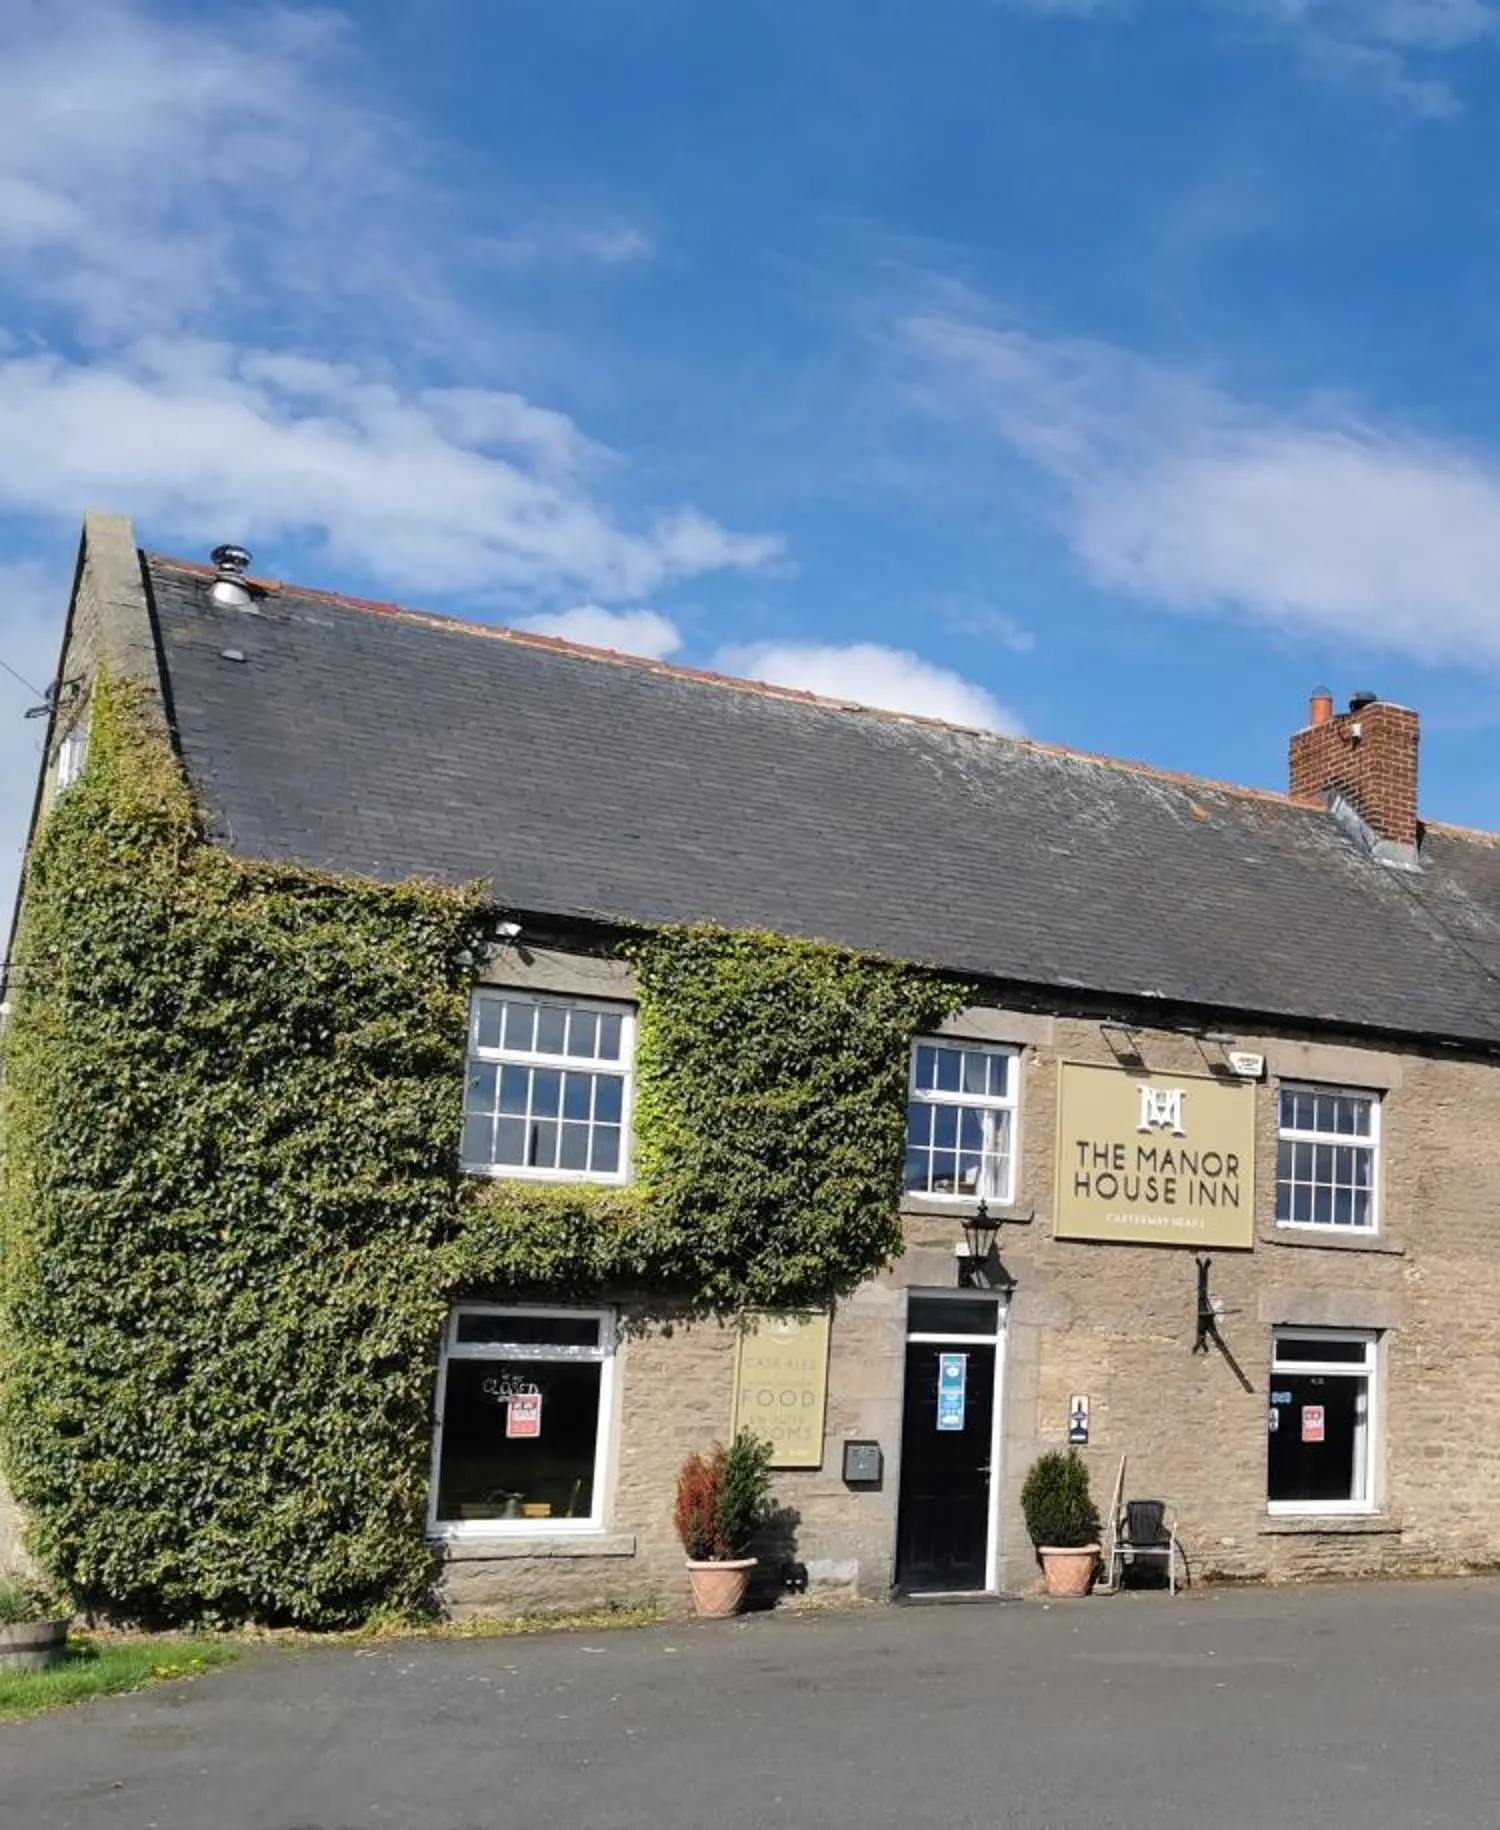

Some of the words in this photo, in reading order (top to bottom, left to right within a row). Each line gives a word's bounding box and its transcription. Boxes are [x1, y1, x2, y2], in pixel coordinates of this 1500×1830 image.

[1076, 1140, 1126, 1171] THE
[1137, 1145, 1239, 1179] MANOR
[1074, 1172, 1177, 1205] HOUSE
[1189, 1179, 1240, 1208] INN
[742, 1387, 816, 1409] FOOD
[746, 1425, 811, 1442] OOMS
